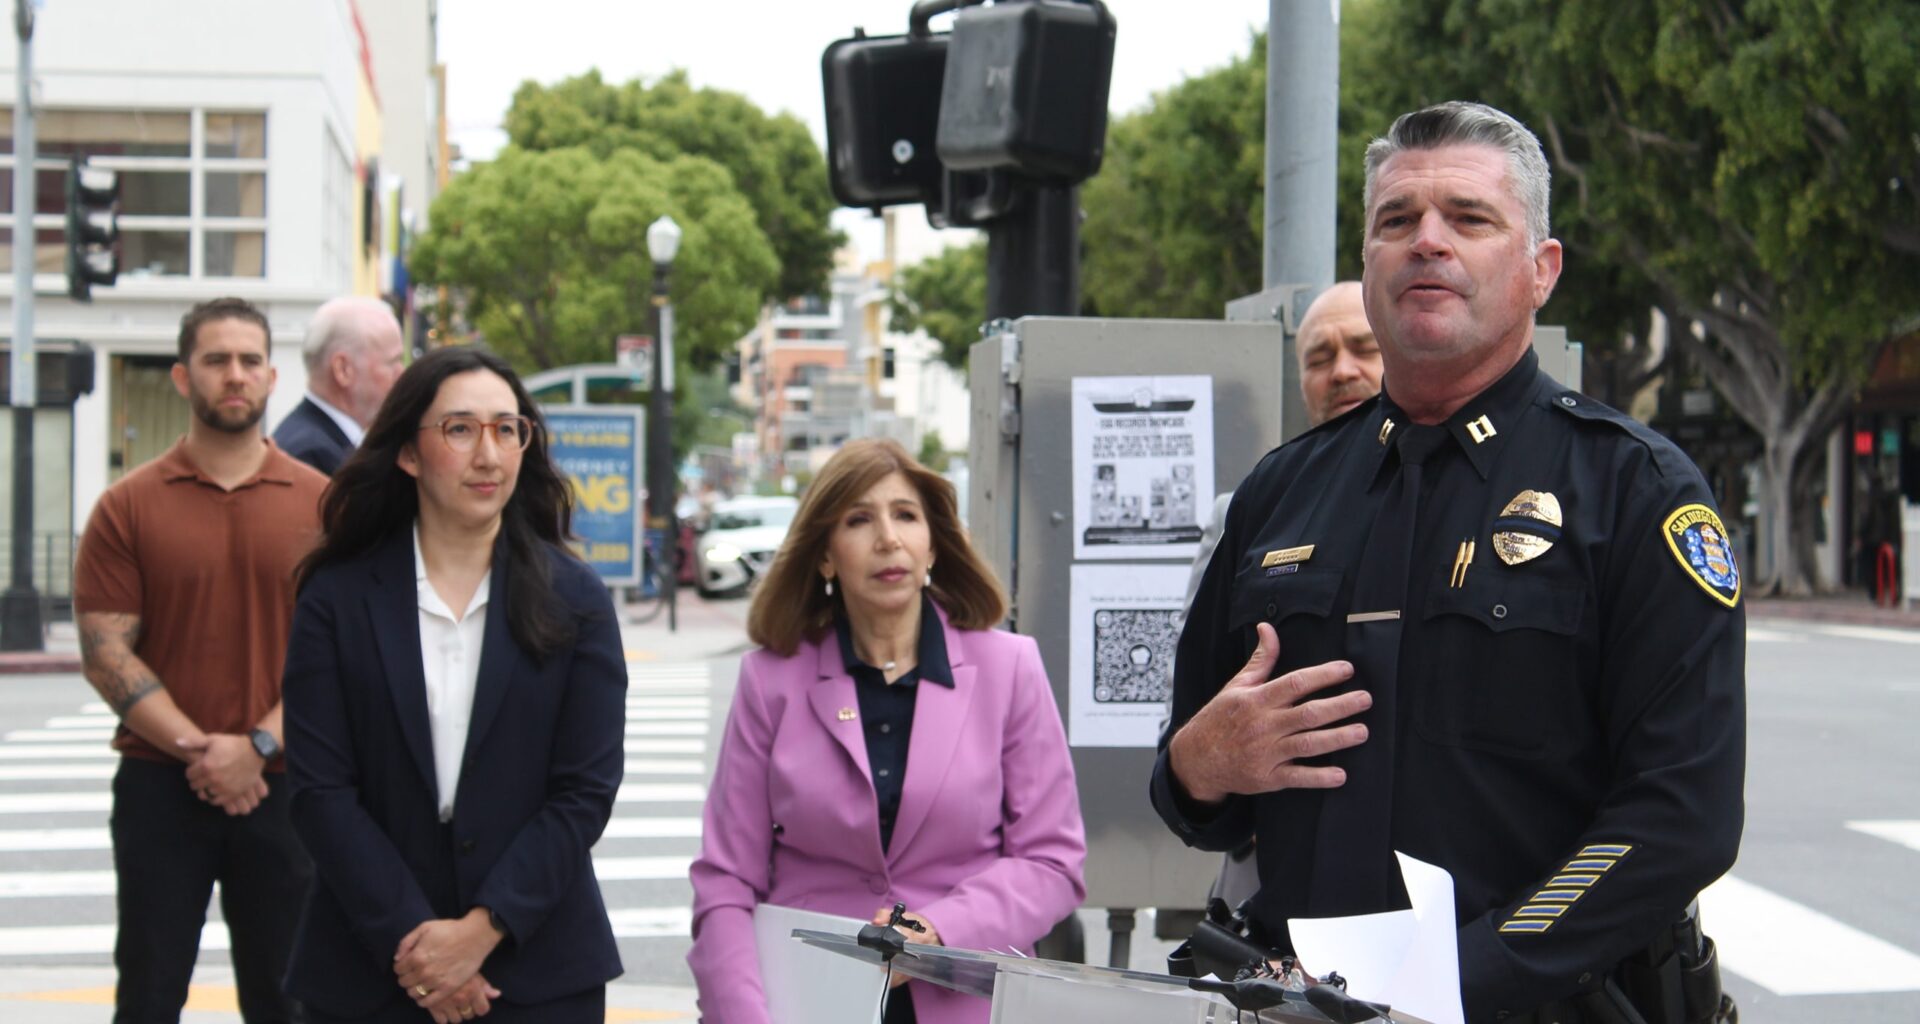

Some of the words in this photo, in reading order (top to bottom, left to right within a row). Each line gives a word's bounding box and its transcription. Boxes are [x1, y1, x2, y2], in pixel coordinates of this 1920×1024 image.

[556, 458, 630, 475] ORNEY
[567, 473, 631, 514] NG
[1671, 514, 1692, 536] SAN
[1686, 510, 1712, 524] DIEGO
